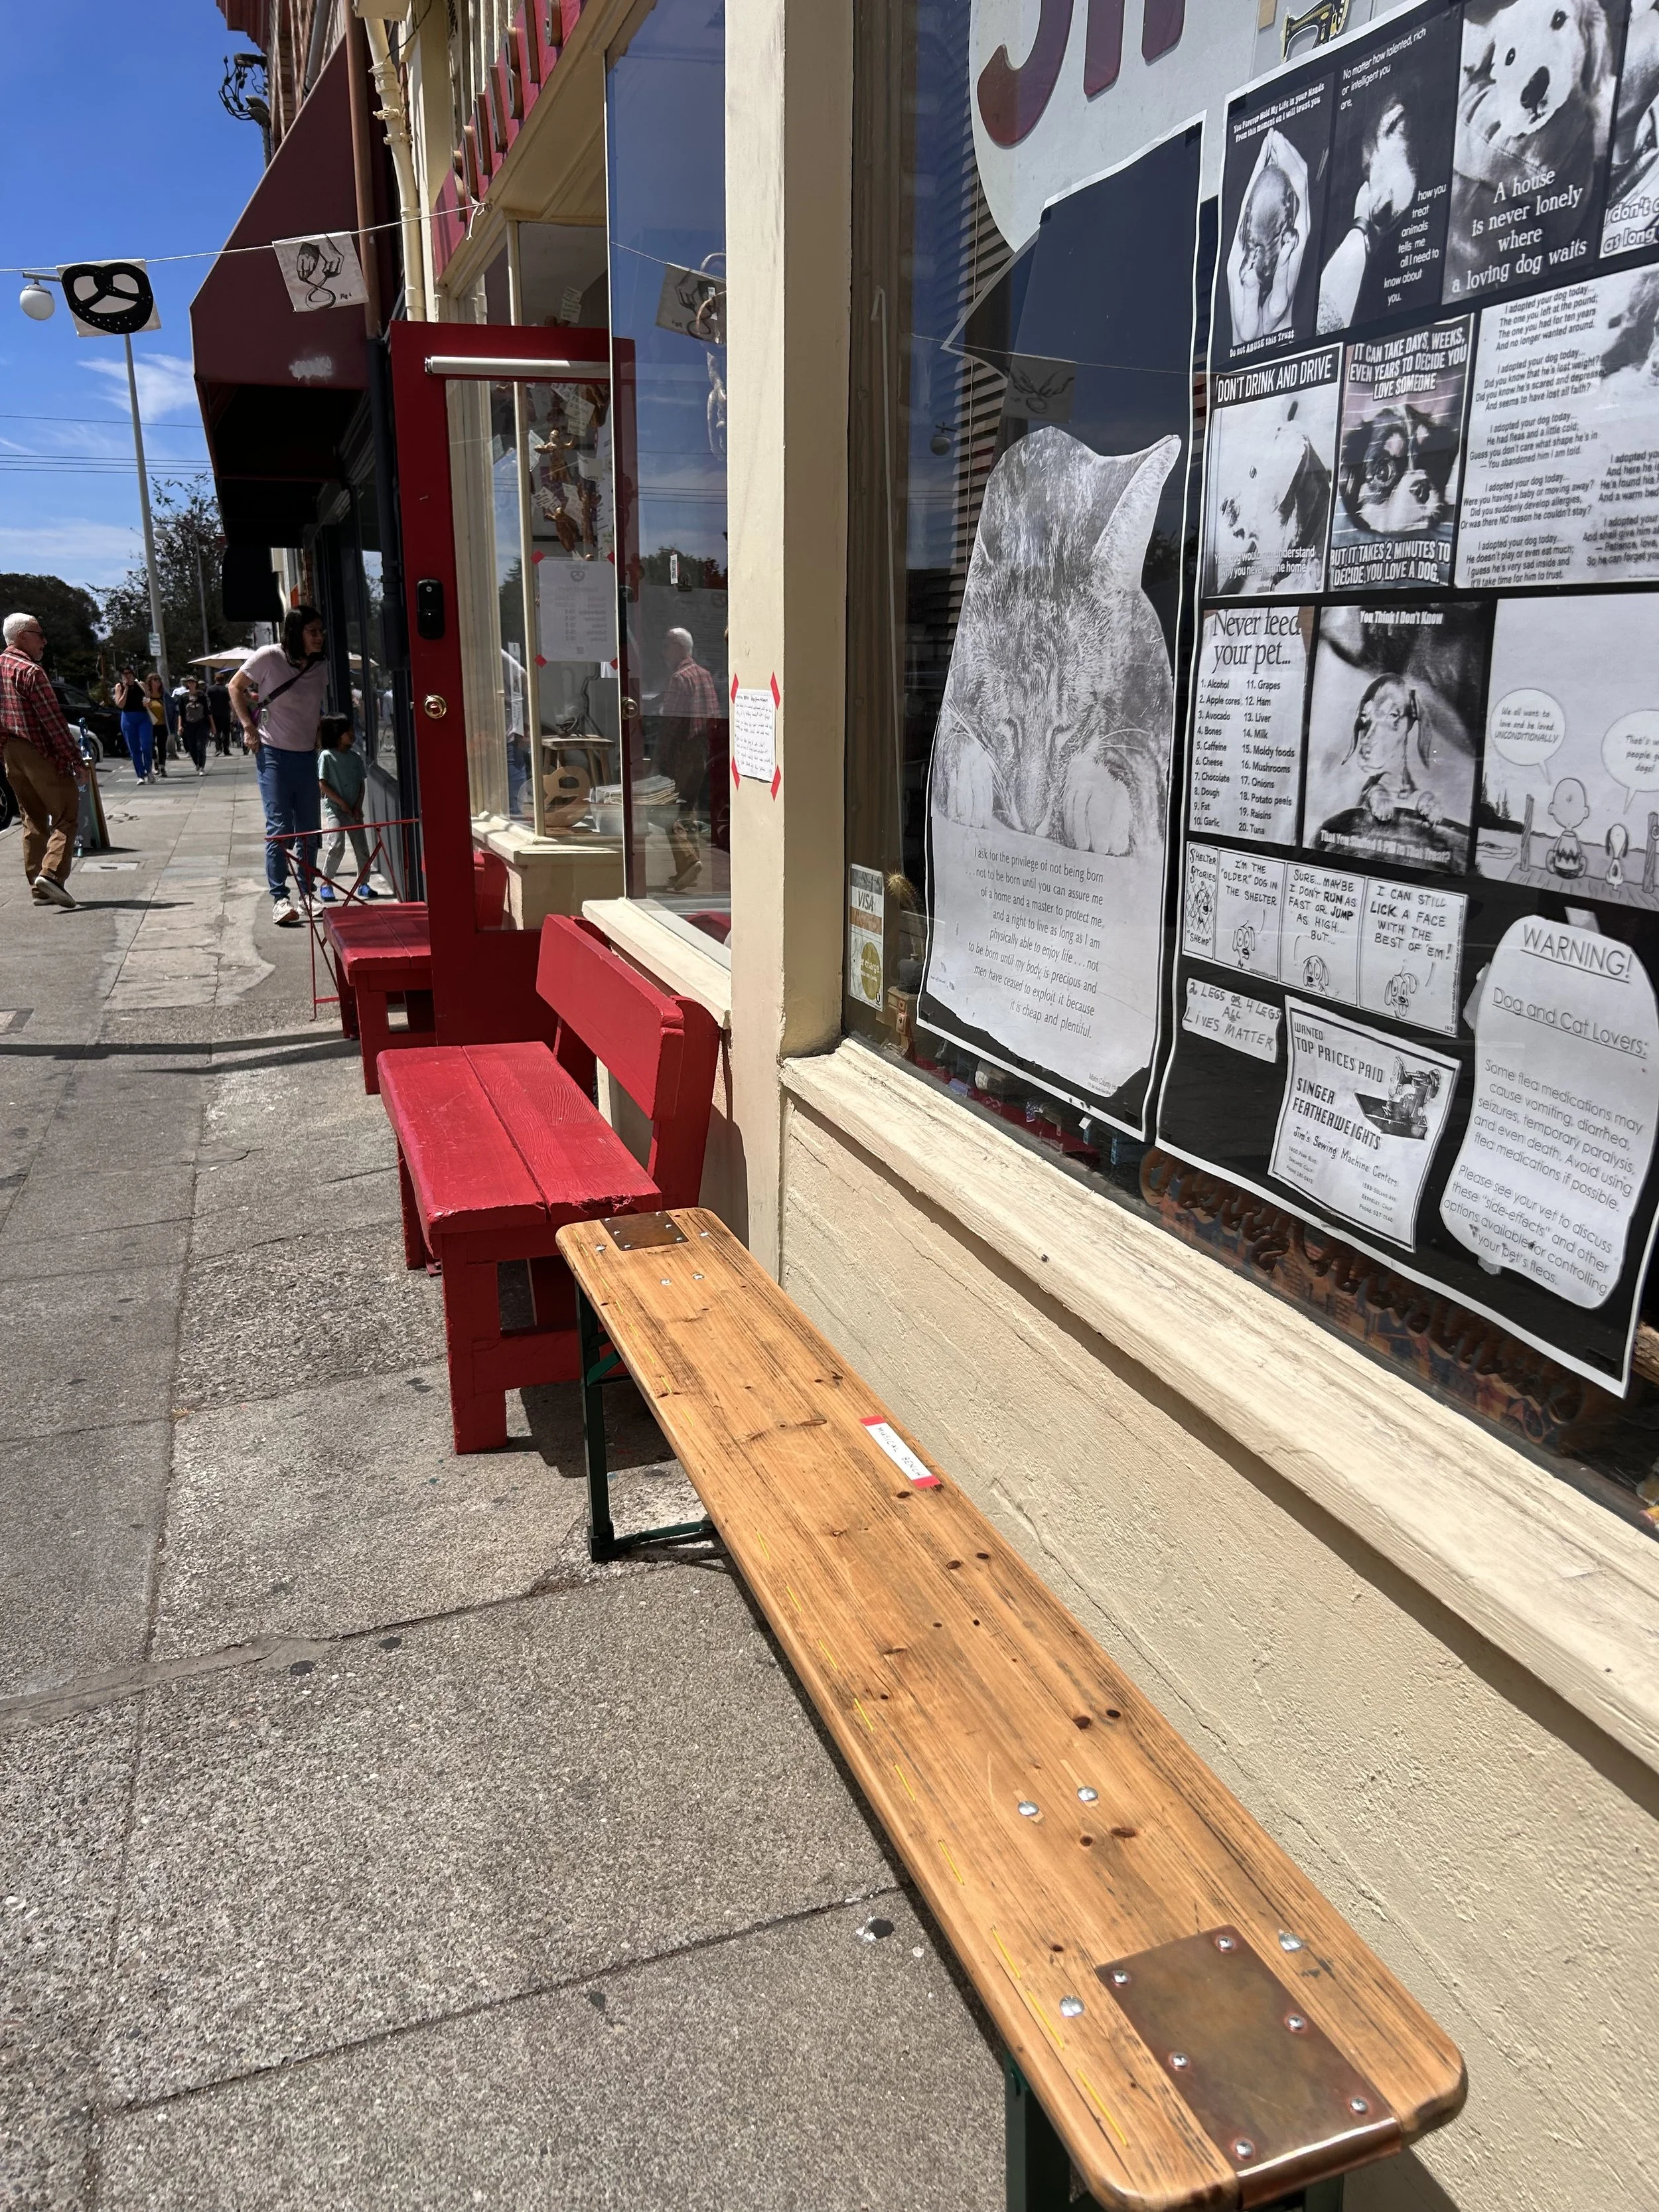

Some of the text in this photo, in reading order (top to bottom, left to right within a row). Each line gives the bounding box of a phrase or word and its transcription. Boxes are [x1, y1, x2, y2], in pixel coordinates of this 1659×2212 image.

[1343, 68, 1351, 79] No
[1352, 58, 1372, 75] matter
[1372, 51, 1386, 64] how
[1413, 28, 1425, 41] rich
[1341, 64, 1390, 96] or intelligent you
[1493, 170, 1555, 203] A house
[1471, 188, 1582, 236] is never lonely
[1610, 196, 1651, 224] don't
[1498, 228, 1542, 251] where
[1603, 226, 1657, 254] as long
[1384, 268, 1422, 287] know about
[1452, 241, 1586, 295] a loving dog waits
[1388, 293, 1401, 305] you.
[1508, 299, 1536, 313] adopted
[1536, 295, 1552, 308] your
[1553, 291, 1567, 301] dog
[1500, 317, 1512, 327] The
[1513, 315, 1525, 323] one
[1526, 312, 1538, 321] you
[1540, 306, 1551, 316] left
[1552, 304, 1559, 313] at
[1560, 301, 1571, 311] the
[1246, 338, 1264, 352] ABUSE
[1265, 335, 1276, 345] this
[1277, 330, 1294, 341] Trust
[1365, 345, 1382, 360] CAN
[1384, 338, 1404, 358] TAKE
[1406, 332, 1428, 354] DAYS,
[1431, 327, 1466, 349] WEEKS,
[1348, 342, 1468, 384] EVEN YEARS TO DECIDE YOU
[1218, 355, 1331, 402] DON'T DRINK AND DRIVE
[1372, 373, 1437, 401] LOVE SOMEONE
[1330, 547, 1347, 567] BUT
[1358, 543, 1386, 563] TAKES
[1394, 539, 1436, 560] MINUTES
[1437, 540, 1451, 561] TO
[1333, 560, 1440, 587] DECIDE YOU LOVE A DOG.
[1213, 608, 1262, 637] Never
[1374, 611, 1395, 624] Think
[1400, 611, 1420, 624] Don't
[1421, 611, 1443, 624] Know
[1212, 644, 1252, 673] your
[1207, 679, 1229, 689] Alcohol
[1258, 680, 1280, 692] Grapes
[977, 848, 987, 859] ask
[989, 849, 997, 861] for
[999, 851, 1009, 863] the
[1011, 855, 1039, 872] privilege
[1040, 859, 1047, 871] of
[1063, 863, 1084, 883] being
[1086, 867, 1102, 882] born
[857, 890, 875, 913] VISA
[1390, 889, 1411, 901] CAN
[1418, 894, 1445, 907] STILL
[1370, 902, 1445, 926] LICK A FACE
[1374, 932, 1404, 948] BEST
[1407, 937, 1423, 952] OF
[1378, 920, 1431, 941] WITH THE
[1524, 925, 1634, 978] WARNING!
[1200, 987, 1224, 1000] LEGS
[1230, 994, 1241, 1008] OR
[1245, 998, 1254, 1011] 4
[1253, 1005, 1282, 1021] LEGS
[1222, 1007, 1240, 1021] ALL
[1294, 1022, 1323, 1040] WANTED
[1493, 988, 1648, 1057] Dog and Cat Lovers:
[1224, 1023, 1273, 1051] MATTER
[1294, 1036, 1383, 1082] TOP PRICES PAID
[1297, 1078, 1334, 1104] SINGER
[1485, 1059, 1643, 1134] Some flea medications may
[1293, 1099, 1380, 1149] FEATHERWEIGHTS
[1313, 1136, 1336, 1159] Sewing
[1340, 1149, 1368, 1171] Machine
[1372, 1165, 1396, 1186] Centers
[901, 1457, 923, 1477] BENCH
